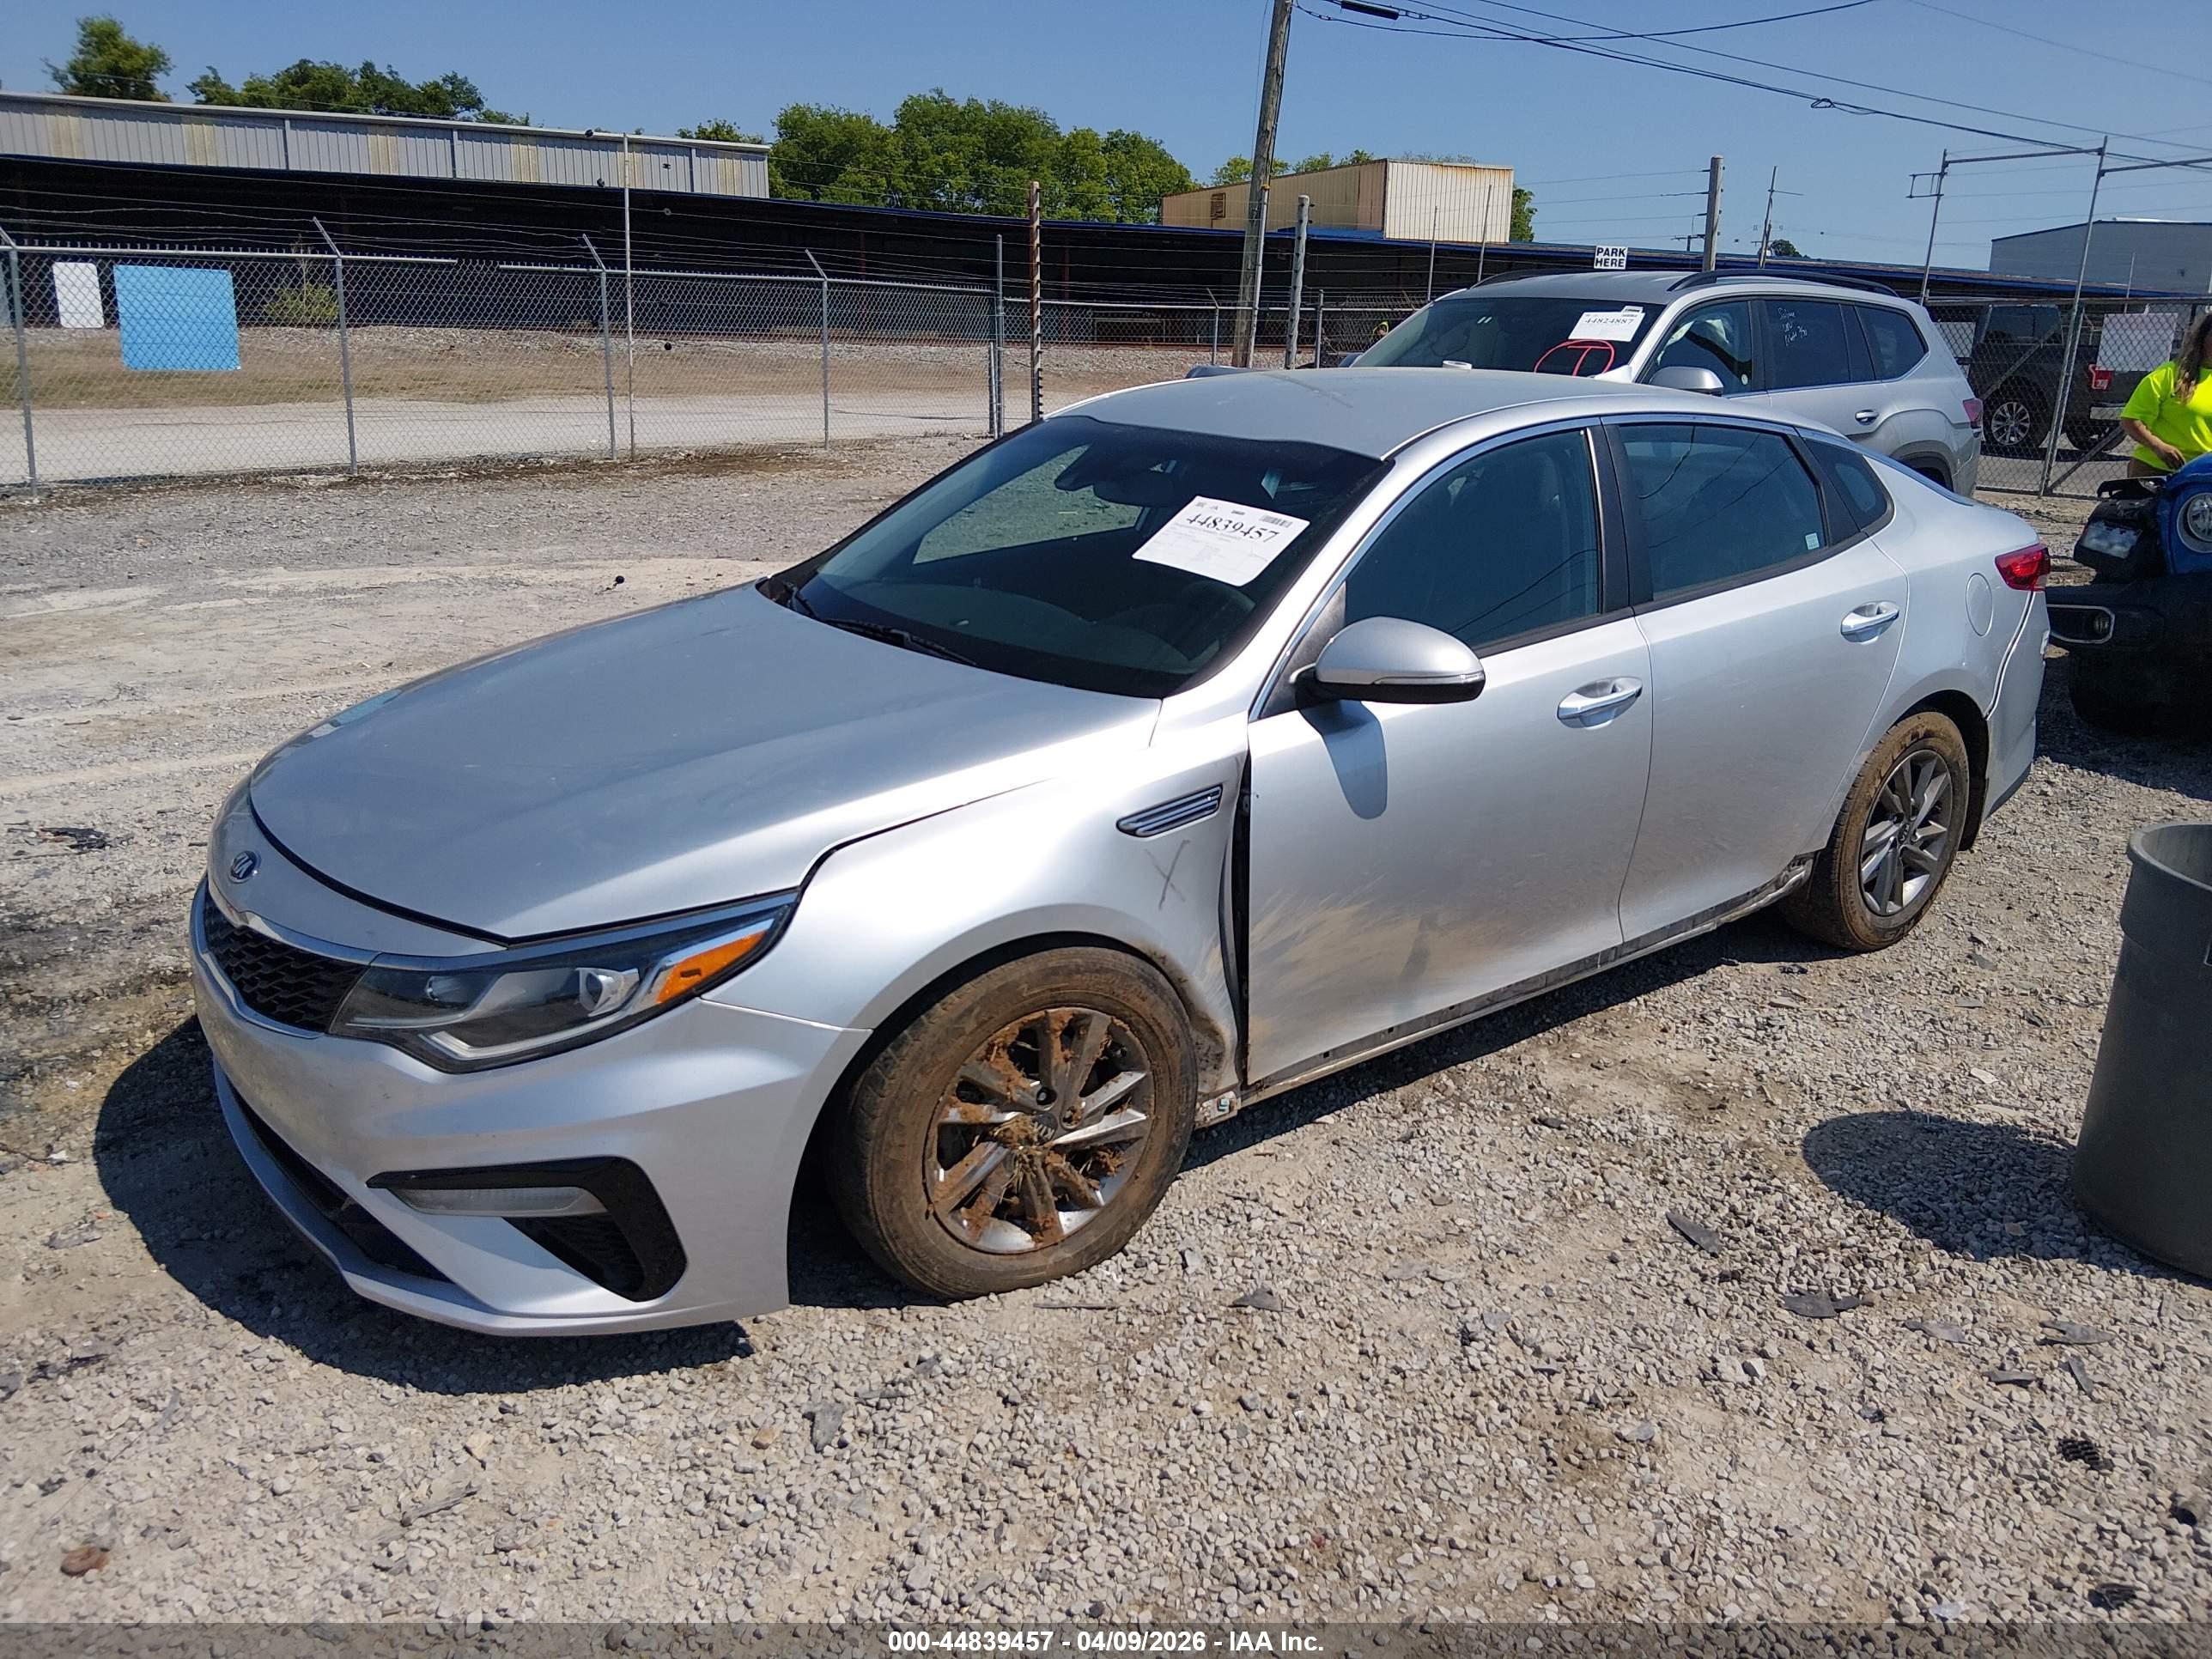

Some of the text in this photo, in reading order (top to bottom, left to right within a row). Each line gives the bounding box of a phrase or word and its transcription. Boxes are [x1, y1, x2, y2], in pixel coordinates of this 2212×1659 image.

[1596, 246, 1626, 258] PARK
[1595, 257, 1626, 268] HERE
[1186, 513, 1280, 543] 44839457
